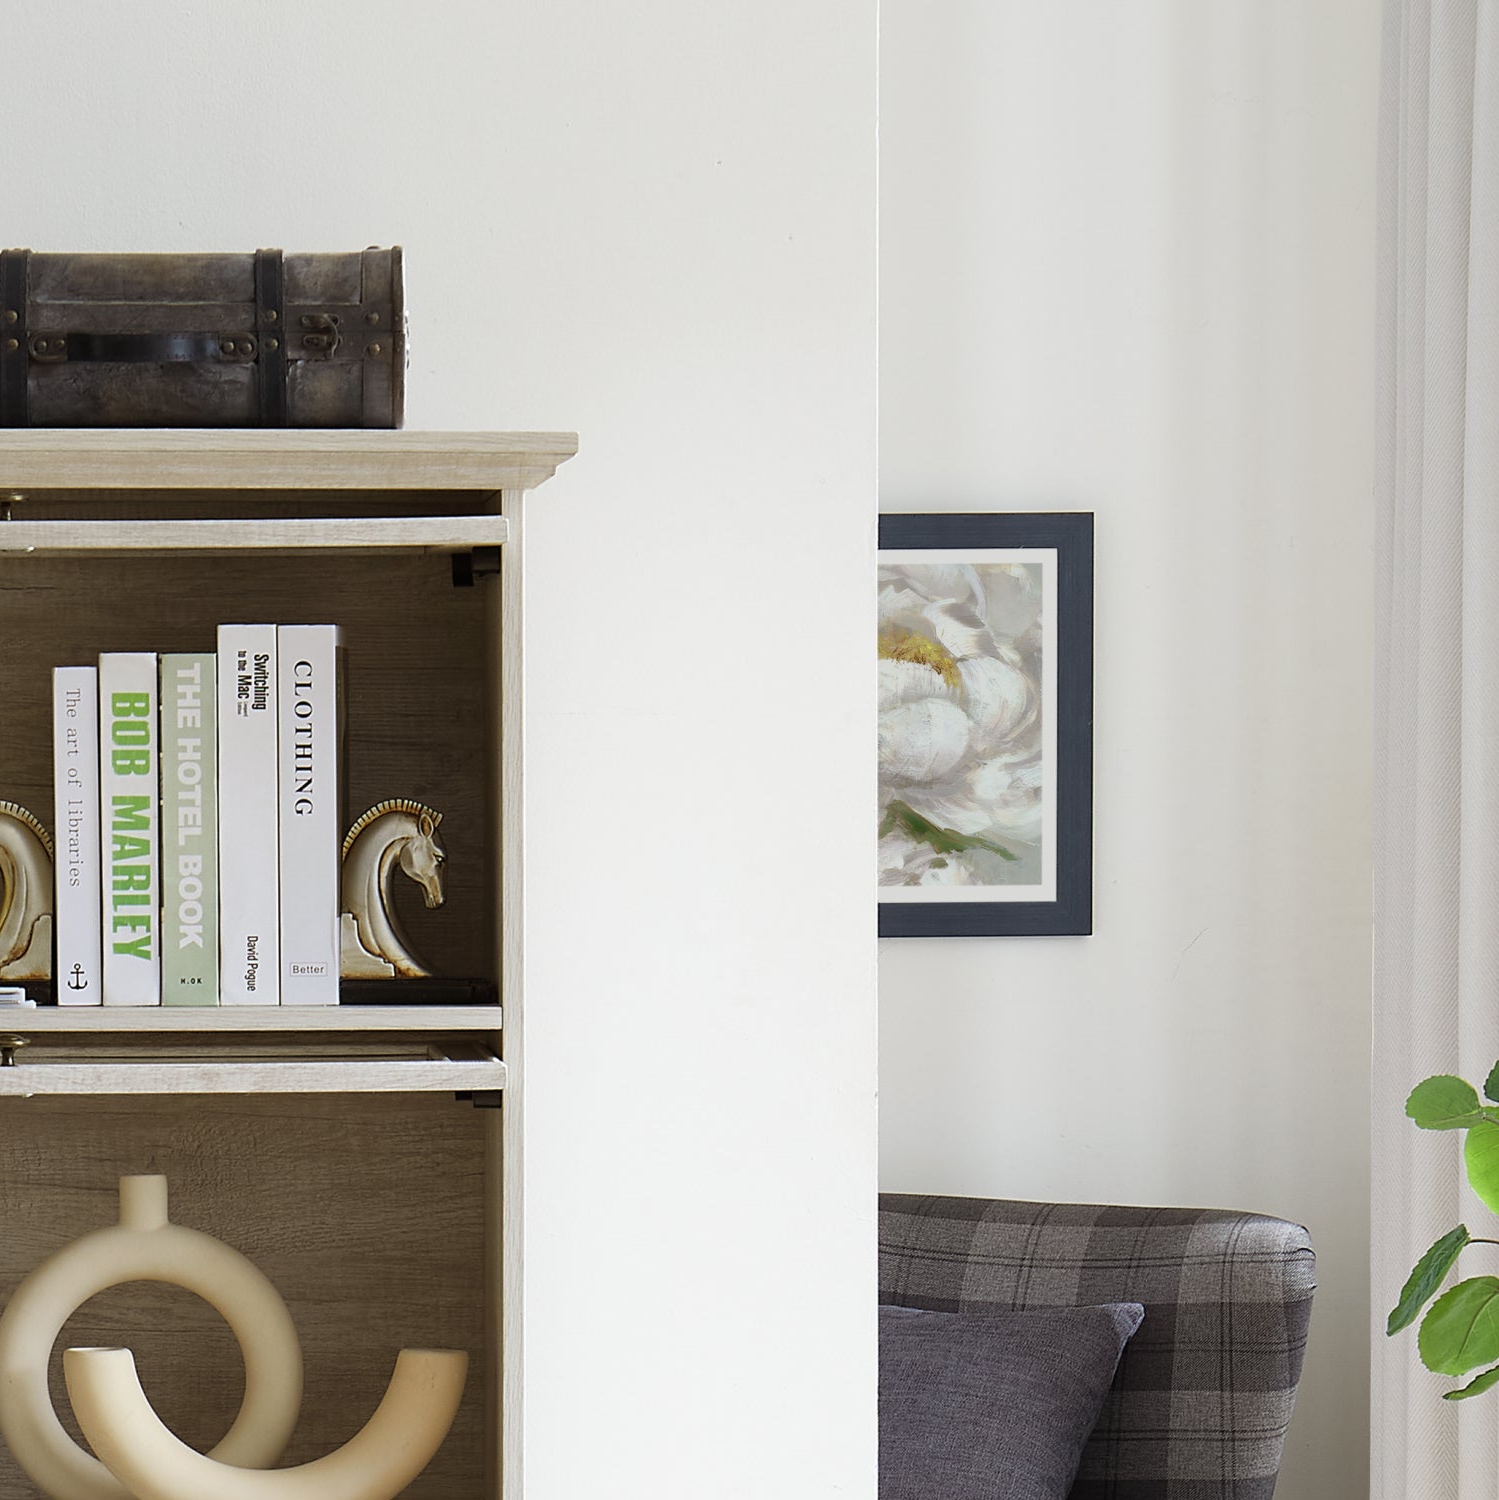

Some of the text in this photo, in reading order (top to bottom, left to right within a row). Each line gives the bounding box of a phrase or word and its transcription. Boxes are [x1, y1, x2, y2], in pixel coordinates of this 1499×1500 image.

[238, 674, 252, 699] Mac
[251, 653, 269, 710] Switching
[66, 688, 84, 888] The art of libraries
[293, 660, 314, 817] CLOTHING
[111, 692, 152, 961] BOB MARLEY
[176, 662, 204, 950] THE HOTEL BOOK
[246, 935, 259, 992] David Pogue
[292, 964, 325, 974] Better
